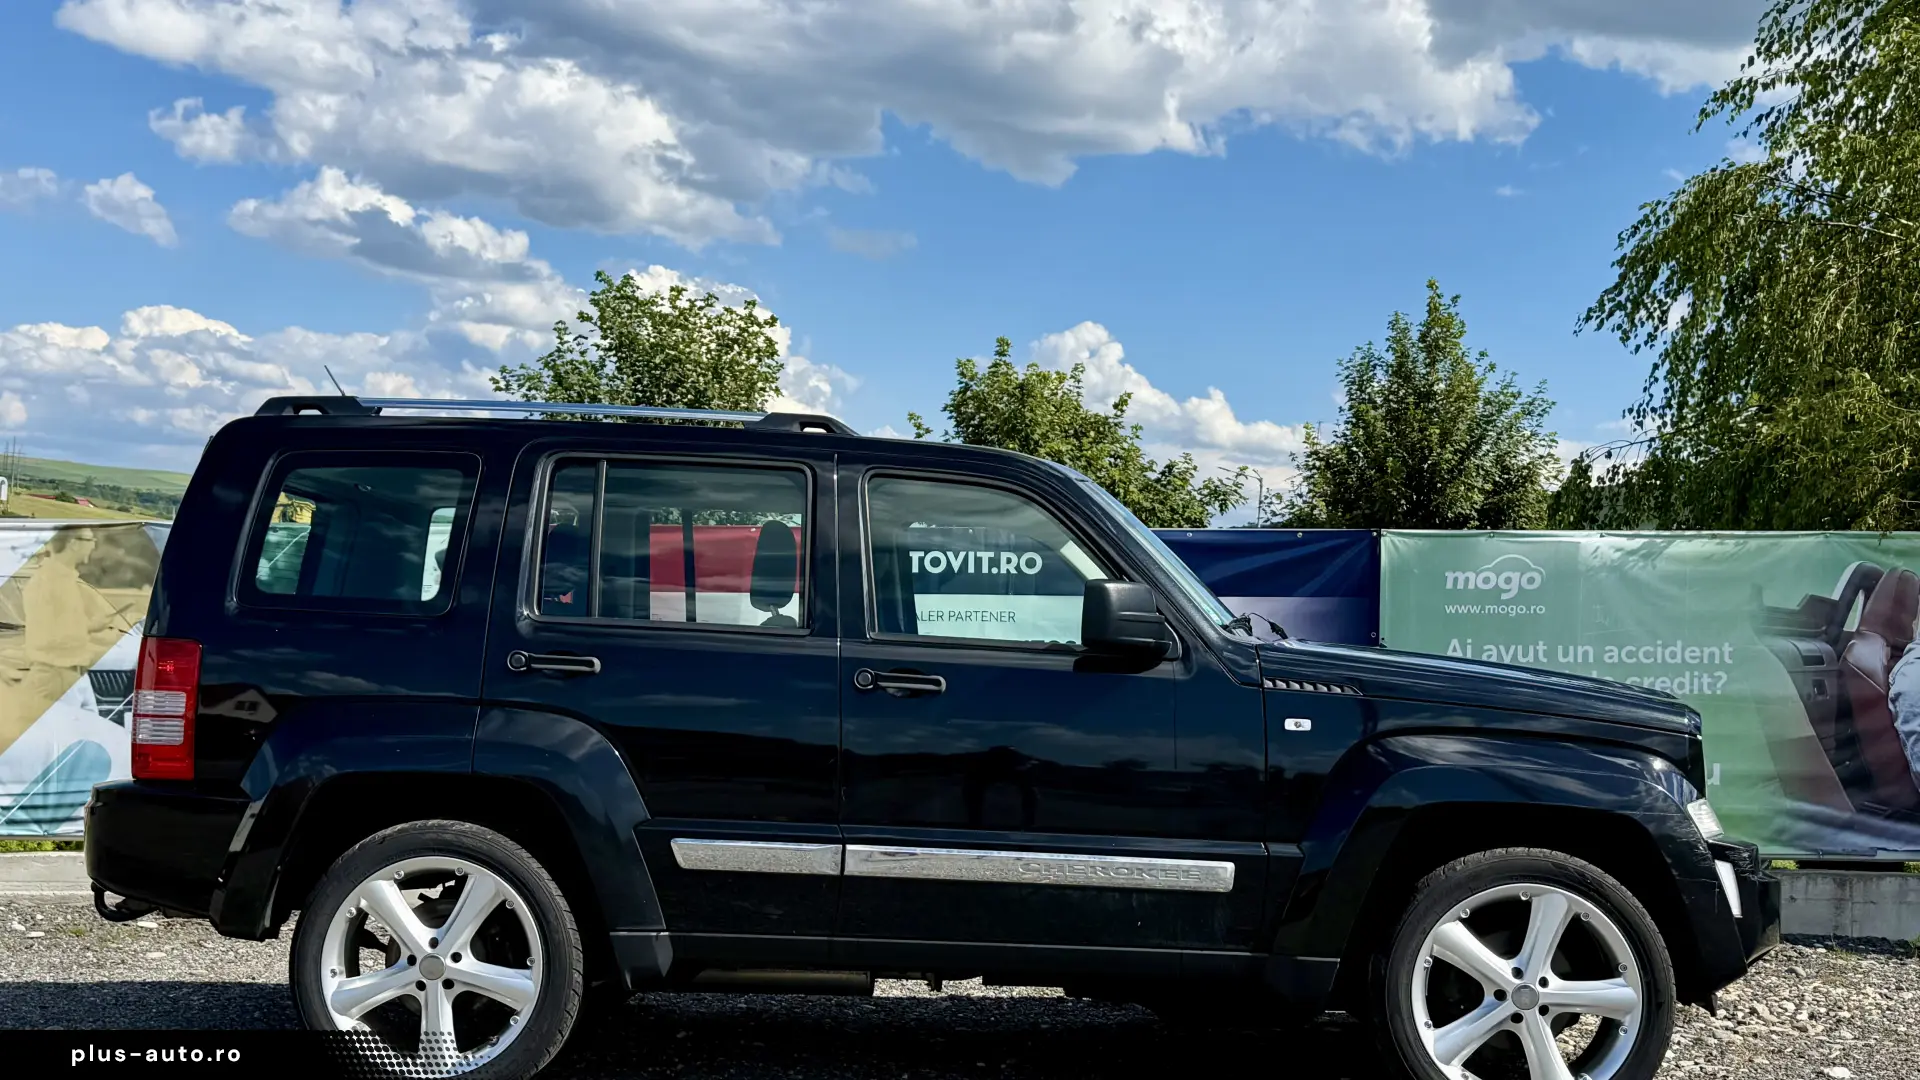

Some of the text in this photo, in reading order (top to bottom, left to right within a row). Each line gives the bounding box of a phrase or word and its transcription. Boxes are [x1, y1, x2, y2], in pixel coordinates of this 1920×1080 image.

[909, 550, 1043, 575] TOVIT.RO
[1445, 569, 1542, 600] mogo
[948, 611, 1016, 623] PARTENER
[1445, 603, 1546, 616] www.mogo.ro
[1446, 638, 1472, 659] Ai
[1557, 644, 1594, 663] un
[1603, 640, 1733, 664] accident
[1018, 863, 1201, 881] CHEROKEE
